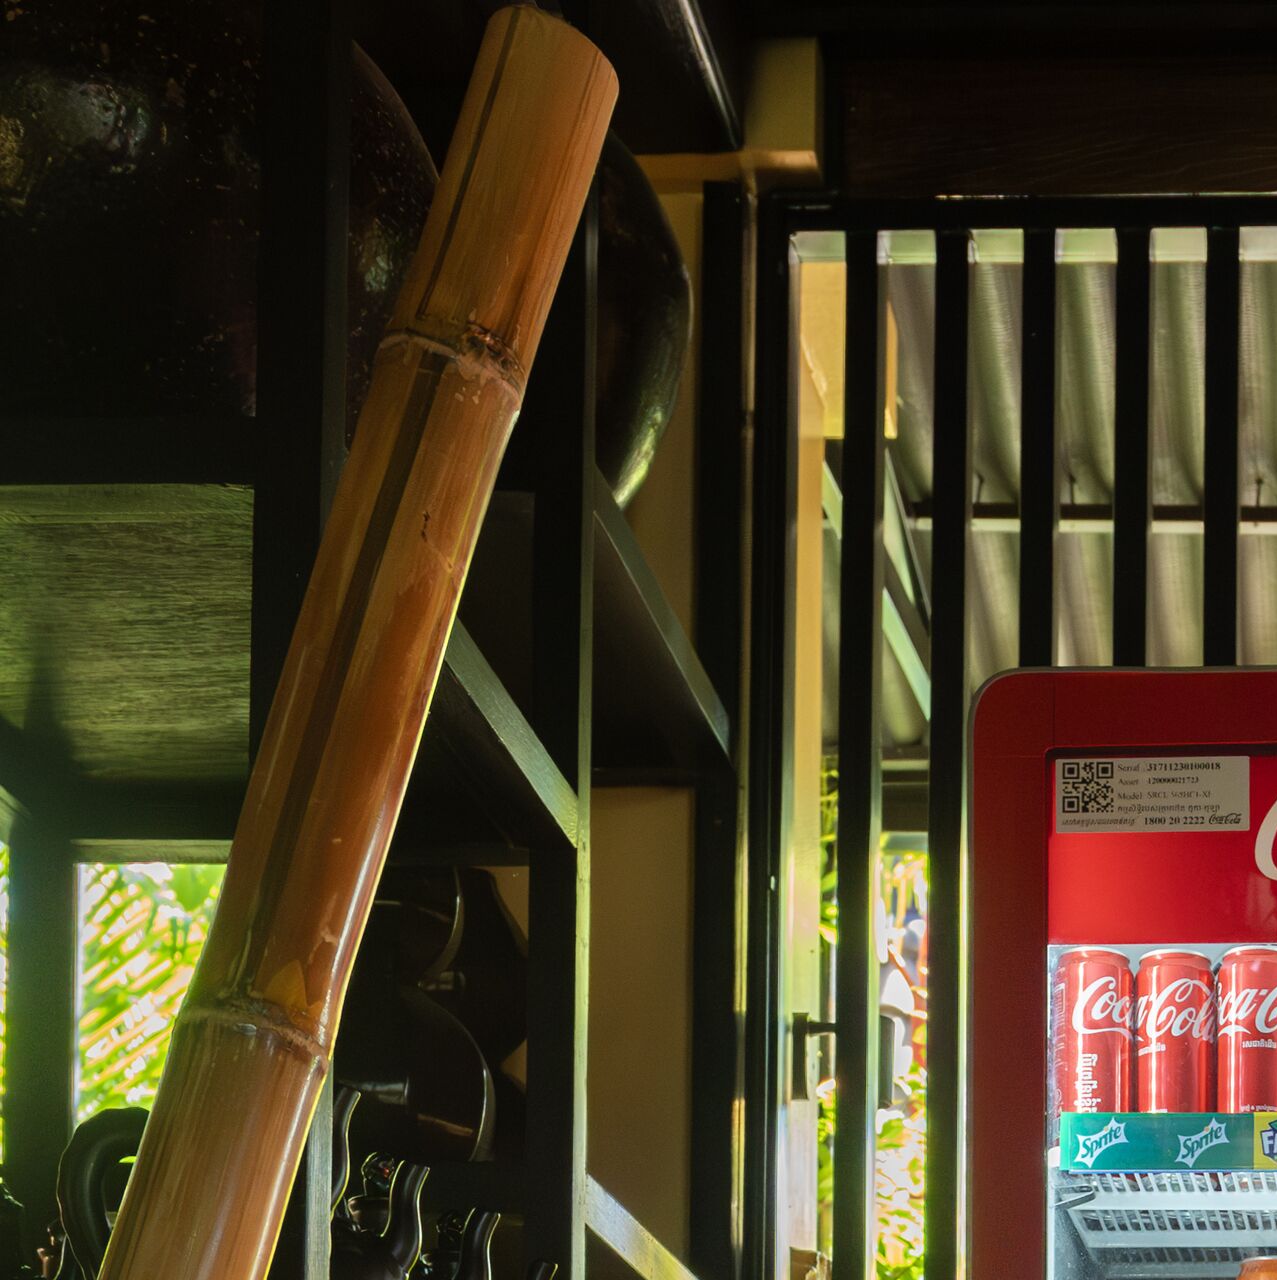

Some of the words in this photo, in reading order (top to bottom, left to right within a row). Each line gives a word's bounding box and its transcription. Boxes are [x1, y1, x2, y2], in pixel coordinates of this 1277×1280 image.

[1144, 817, 1166, 826] 1800
[1169, 817, 1181, 825] 20
[1183, 816, 1205, 825] 2222
[1080, 1124, 1125, 1157] Sprite
[1178, 1124, 1225, 1158] Sprite
